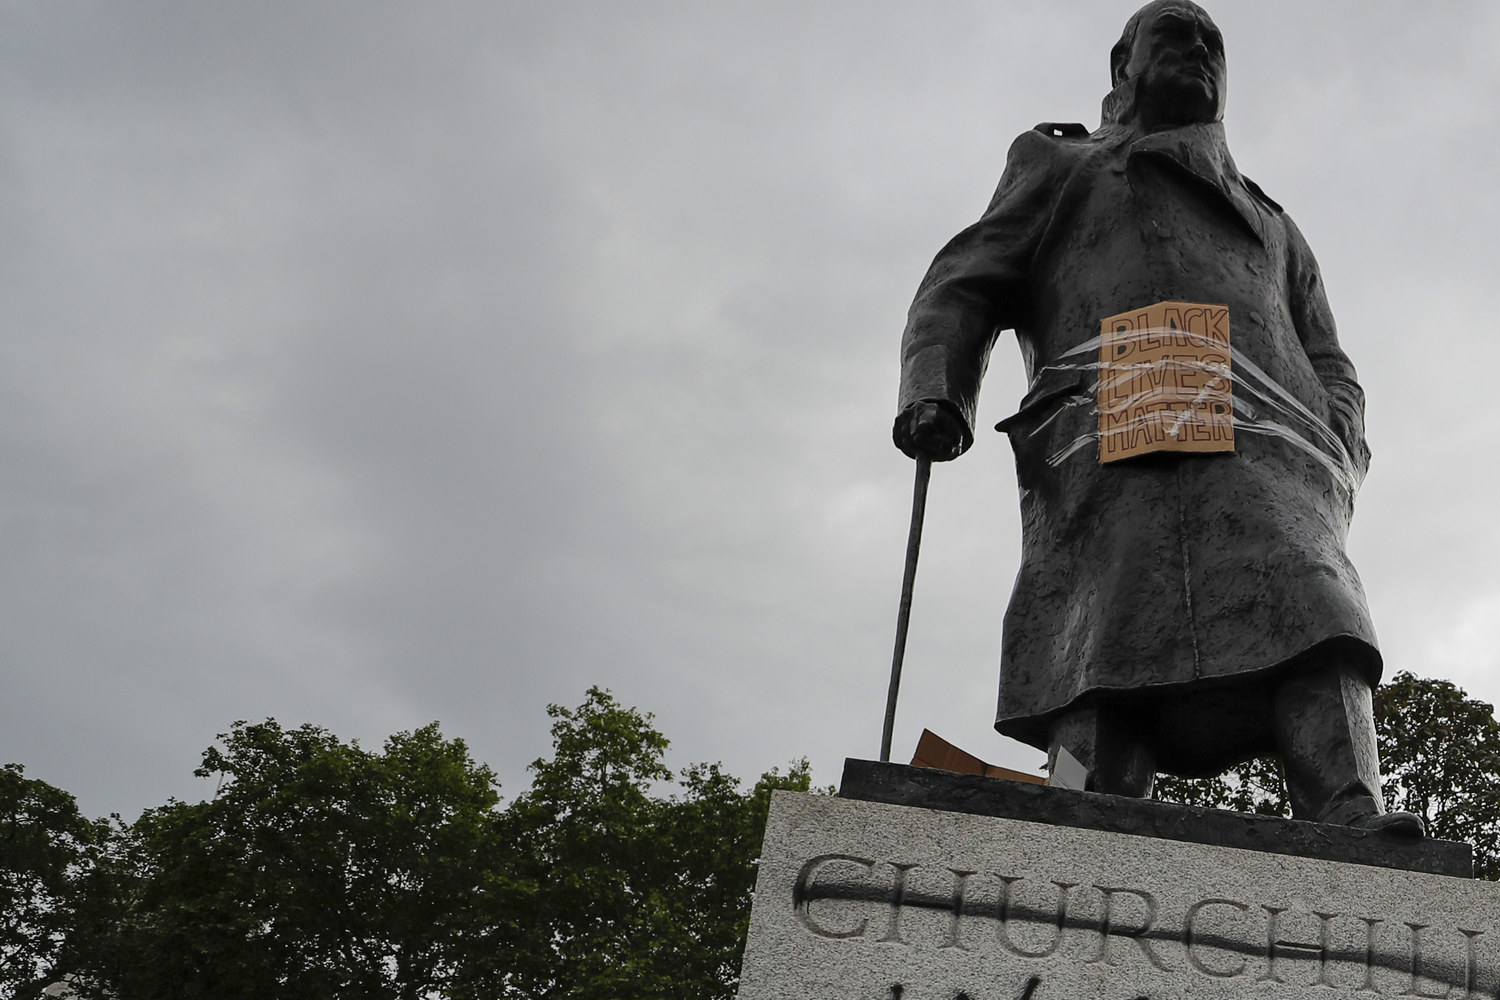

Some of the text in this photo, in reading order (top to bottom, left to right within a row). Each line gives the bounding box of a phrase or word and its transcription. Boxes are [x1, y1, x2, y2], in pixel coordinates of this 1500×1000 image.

[1111, 307, 1229, 363] BLACK
[1106, 353, 1231, 409] LIVES
[1106, 400, 1234, 454] MATTER
